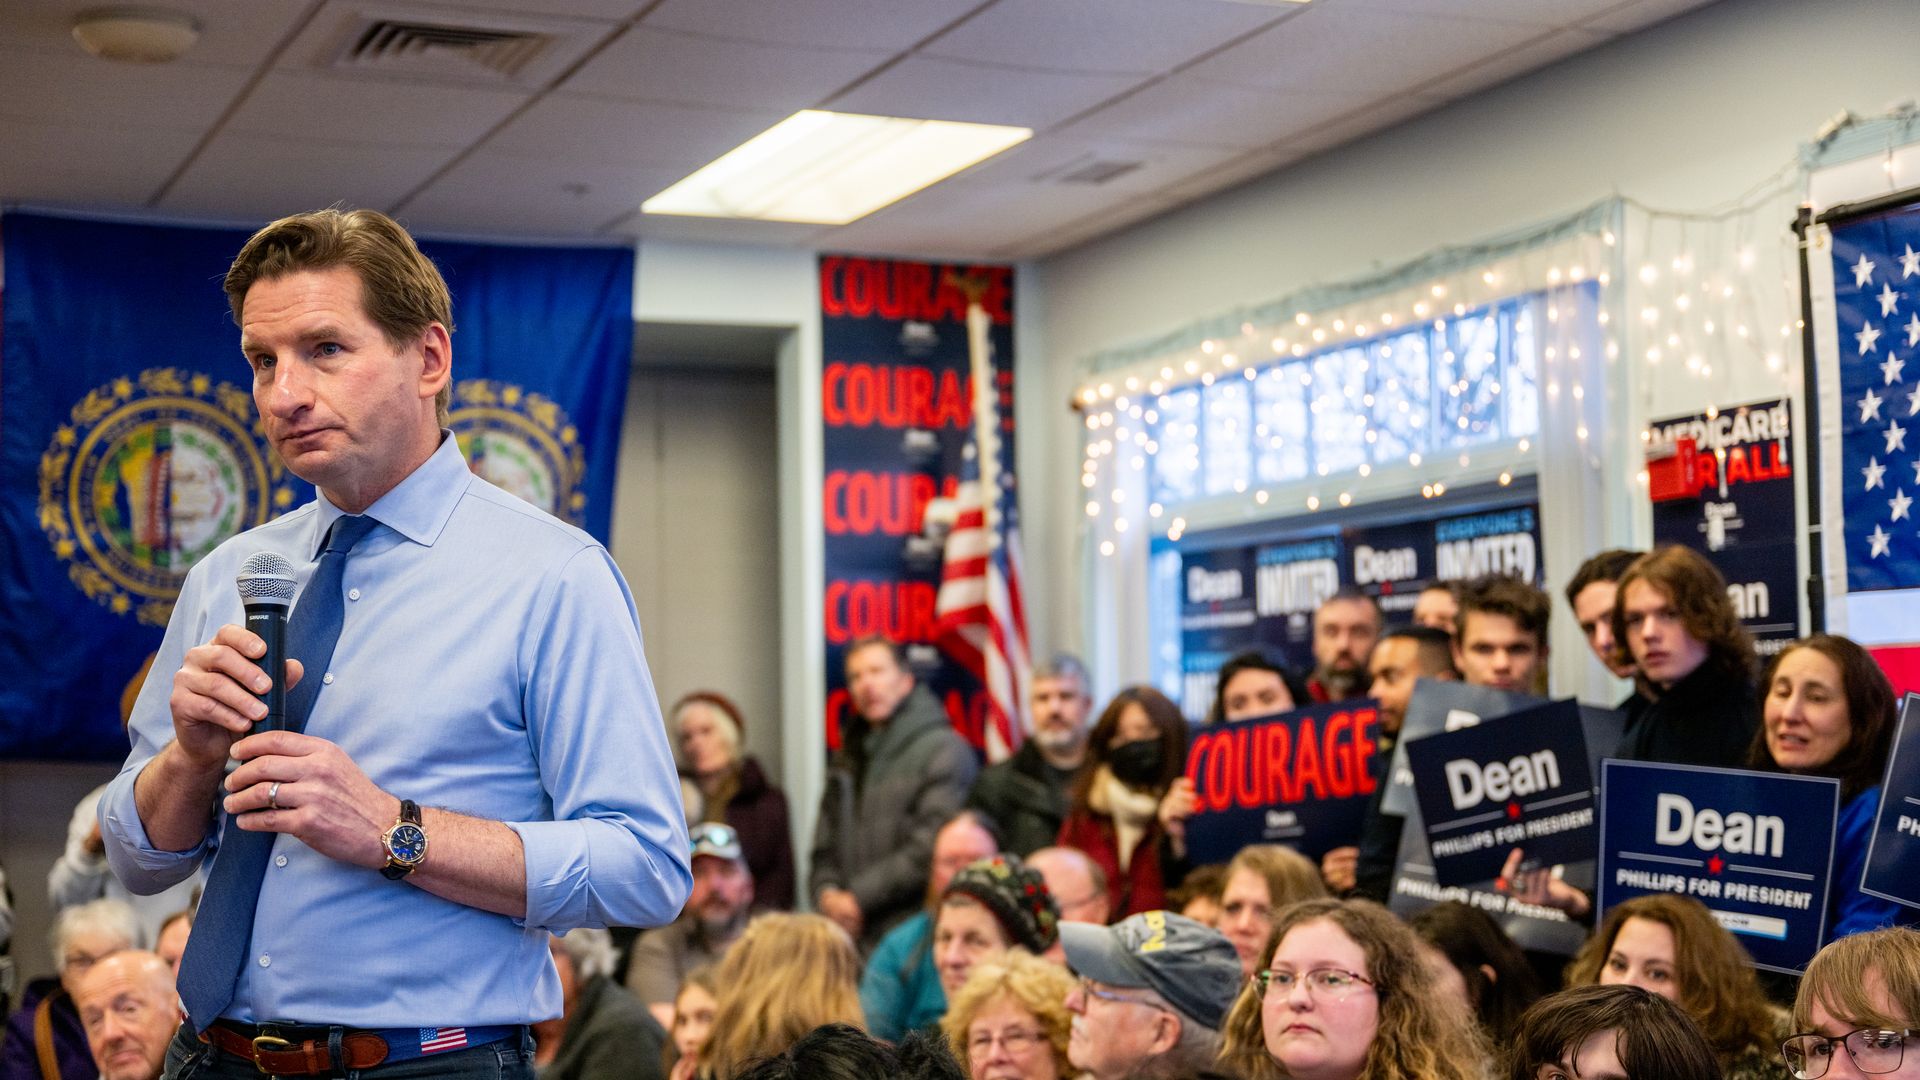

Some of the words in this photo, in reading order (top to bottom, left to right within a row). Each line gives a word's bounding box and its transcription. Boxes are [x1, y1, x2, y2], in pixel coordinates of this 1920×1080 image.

[1727, 441, 1792, 485] ALL
[1354, 545, 1417, 585] Dean
[1437, 532, 1535, 585] INVITED
[1188, 566, 1242, 603] Dean
[825, 580, 938, 644] COUR
[1186, 709, 1377, 813] COURAGE
[1445, 749, 1561, 810] Dean
[1432, 830, 1495, 858] PHILLIPS
[1495, 823, 1526, 845] FOR
[1525, 808, 1594, 838] PRESIDENT
[1655, 792, 1785, 858] Dean
[1397, 876, 1470, 904] PHILLIPS
[1470, 890, 1506, 912] FOR
[1616, 868, 1686, 893] PHILLIPS
[1688, 876, 1721, 898] FOR
[1724, 882, 1813, 910] PRESIDENT
